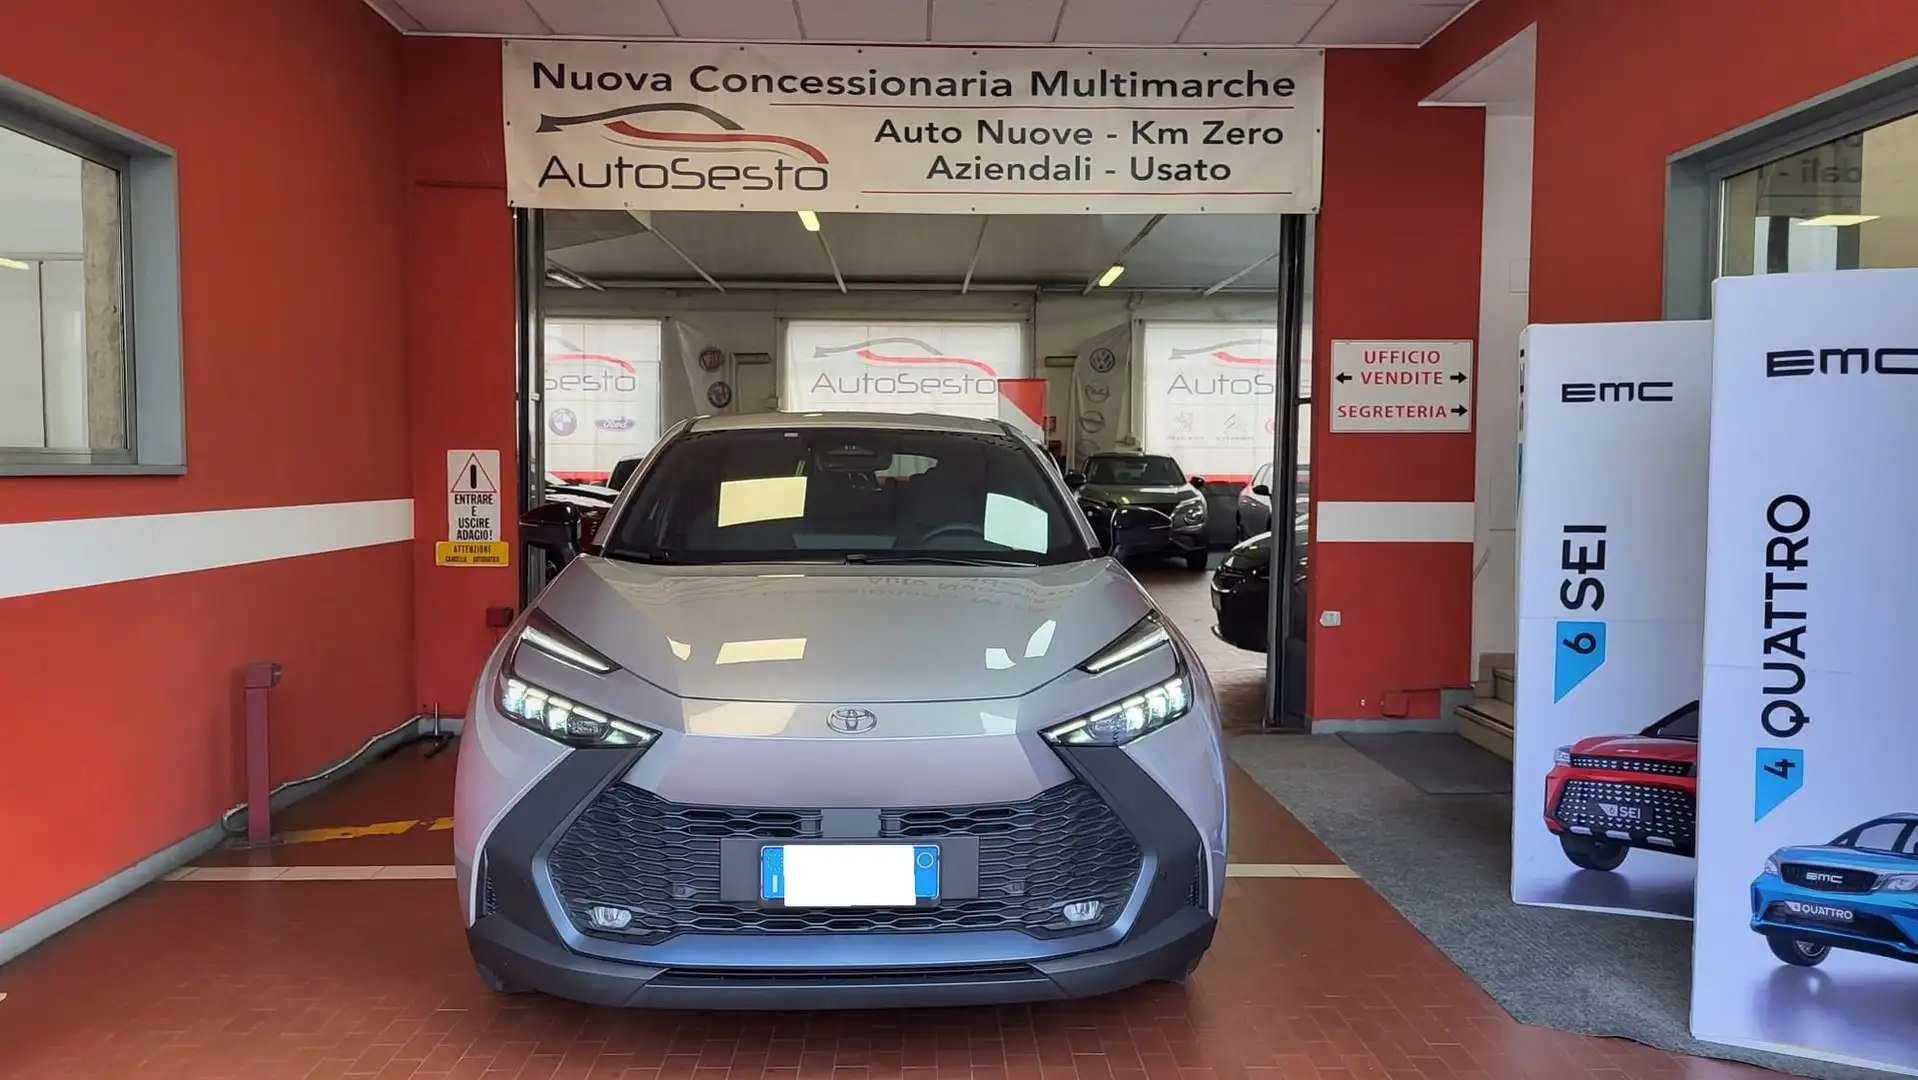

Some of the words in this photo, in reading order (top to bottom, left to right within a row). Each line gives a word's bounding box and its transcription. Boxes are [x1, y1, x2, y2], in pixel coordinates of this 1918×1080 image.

[532, 62, 672, 91] Nuova
[689, 66, 1012, 97] Concessionaria
[1031, 69, 1296, 97] Multimarche
[874, 119, 962, 144] Auto
[977, 120, 1093, 145] Nuove
[1132, 121, 1189, 145] Km
[1202, 121, 1284, 145] Zero
[538, 156, 829, 190] AutoSesto
[926, 155, 1092, 181] Aziendali
[1130, 157, 1232, 181] Usato
[1364, 350, 1441, 364] UFFICIO
[1766, 347, 1918, 378] EMC
[810, 372, 996, 395] AutoSesto
[1360, 371, 1443, 385] VENDITE
[1561, 381, 1674, 403] EMC
[1337, 405, 1447, 418] SEGRETERIA
[454, 493, 494, 505] ENTRARE
[471, 505, 477, 517] E
[458, 517, 490, 529] USCIRE
[456, 529, 493, 541] ADAGIO!
[1559, 525, 1607, 612] SEI
[1761, 494, 1811, 738] QUATTRO
[1562, 632, 1597, 655] 6
[1763, 758, 1796, 780] 4
[1619, 806, 1641, 820] SEI
[1802, 903, 1854, 920] QUATTRO
